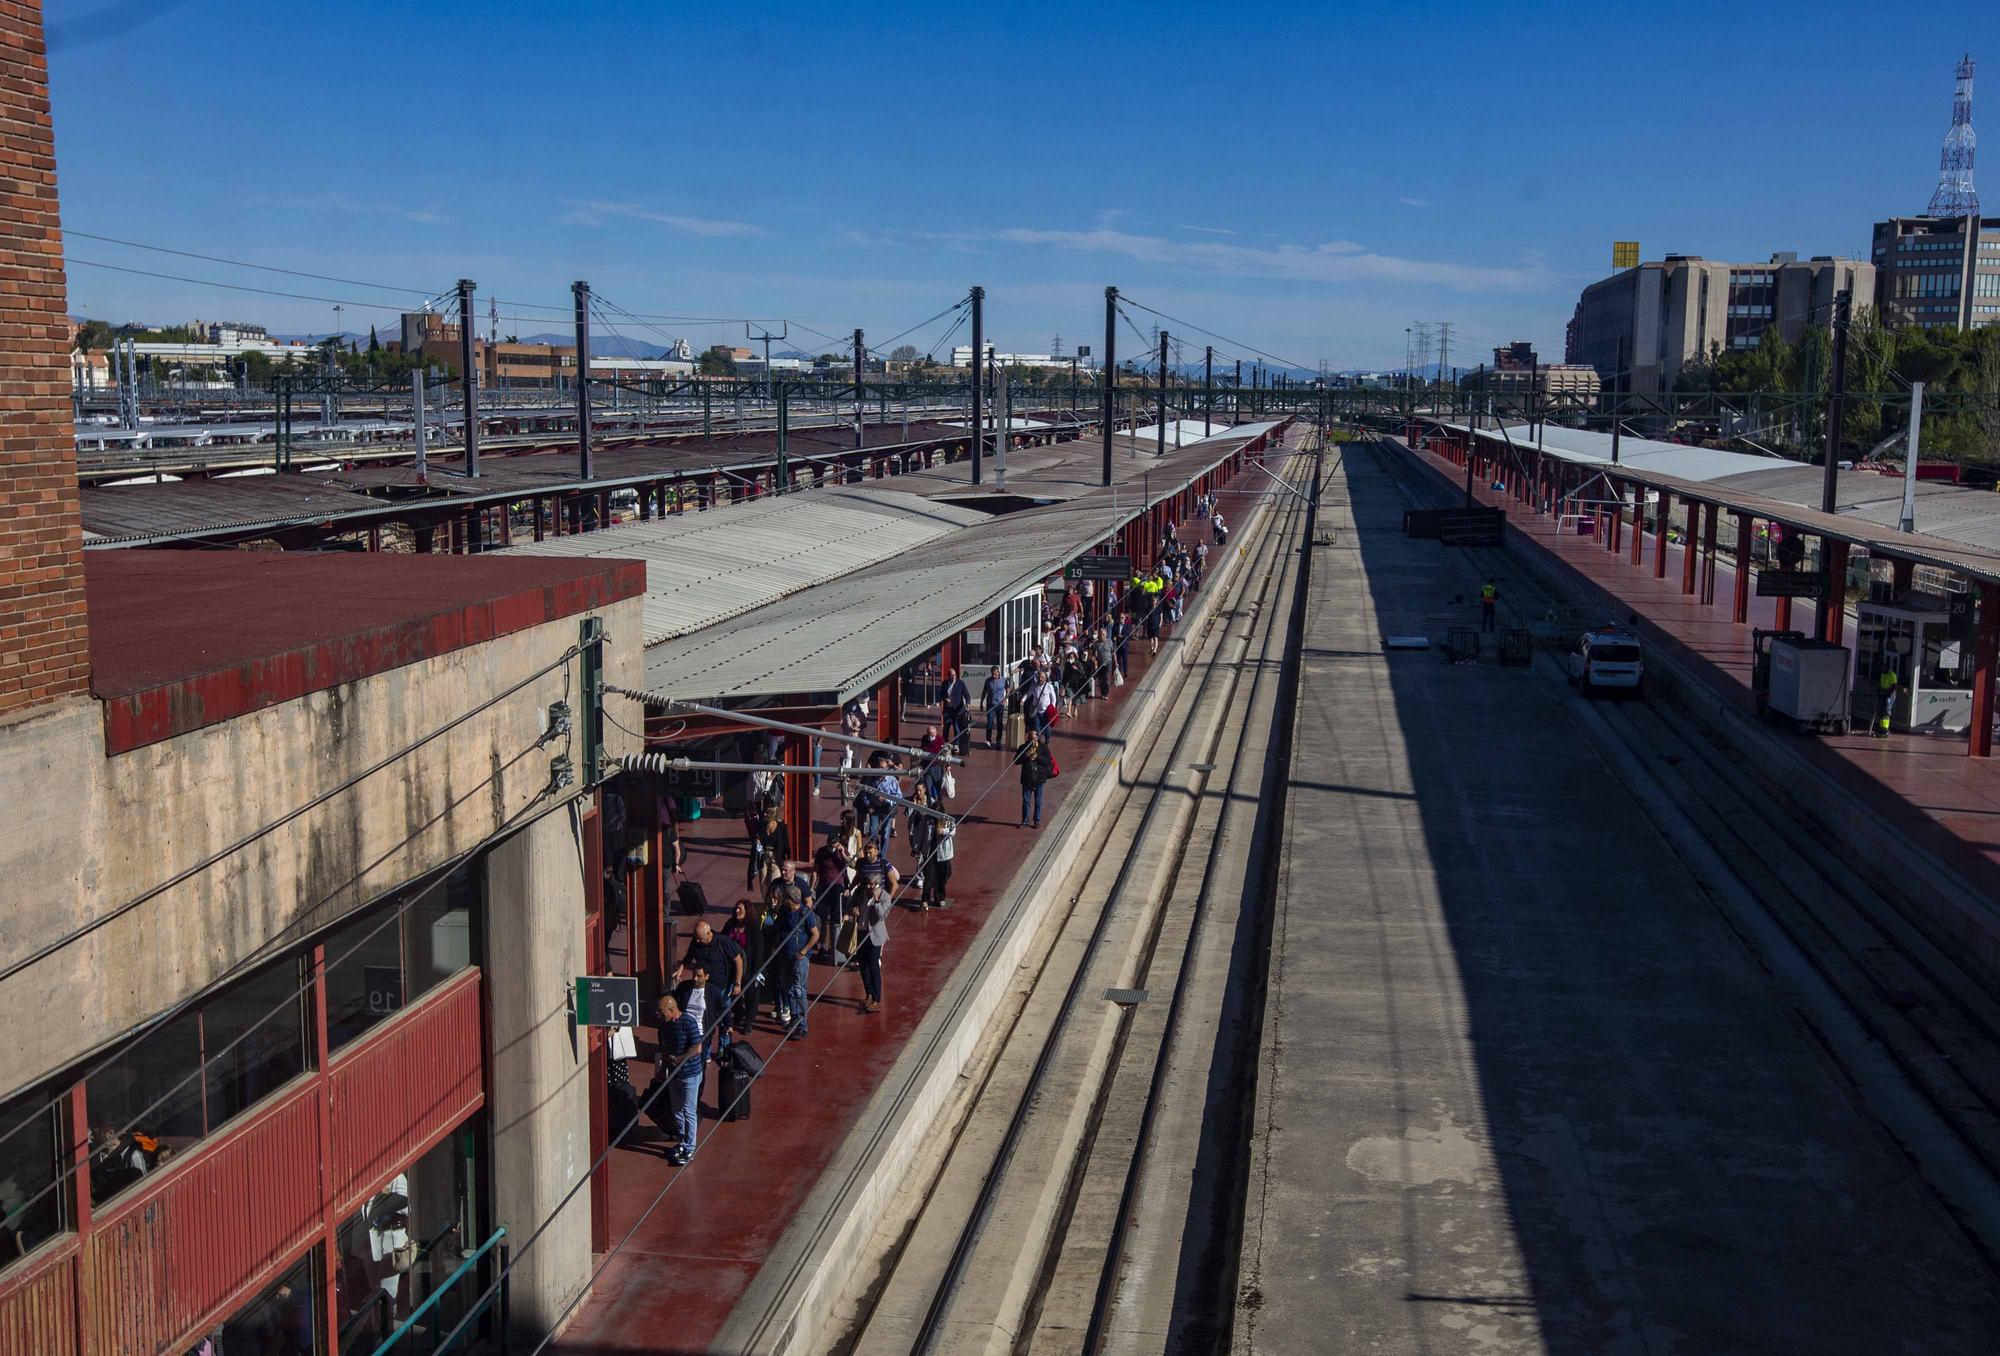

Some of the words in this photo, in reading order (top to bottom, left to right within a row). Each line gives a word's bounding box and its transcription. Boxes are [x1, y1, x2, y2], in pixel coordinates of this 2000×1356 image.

[1071, 568, 1082, 578] 19
[1810, 586, 1822, 595] 20
[1952, 602, 1966, 613] 20
[691, 769, 713, 785] 19
[606, 1001, 632, 1024] 19
